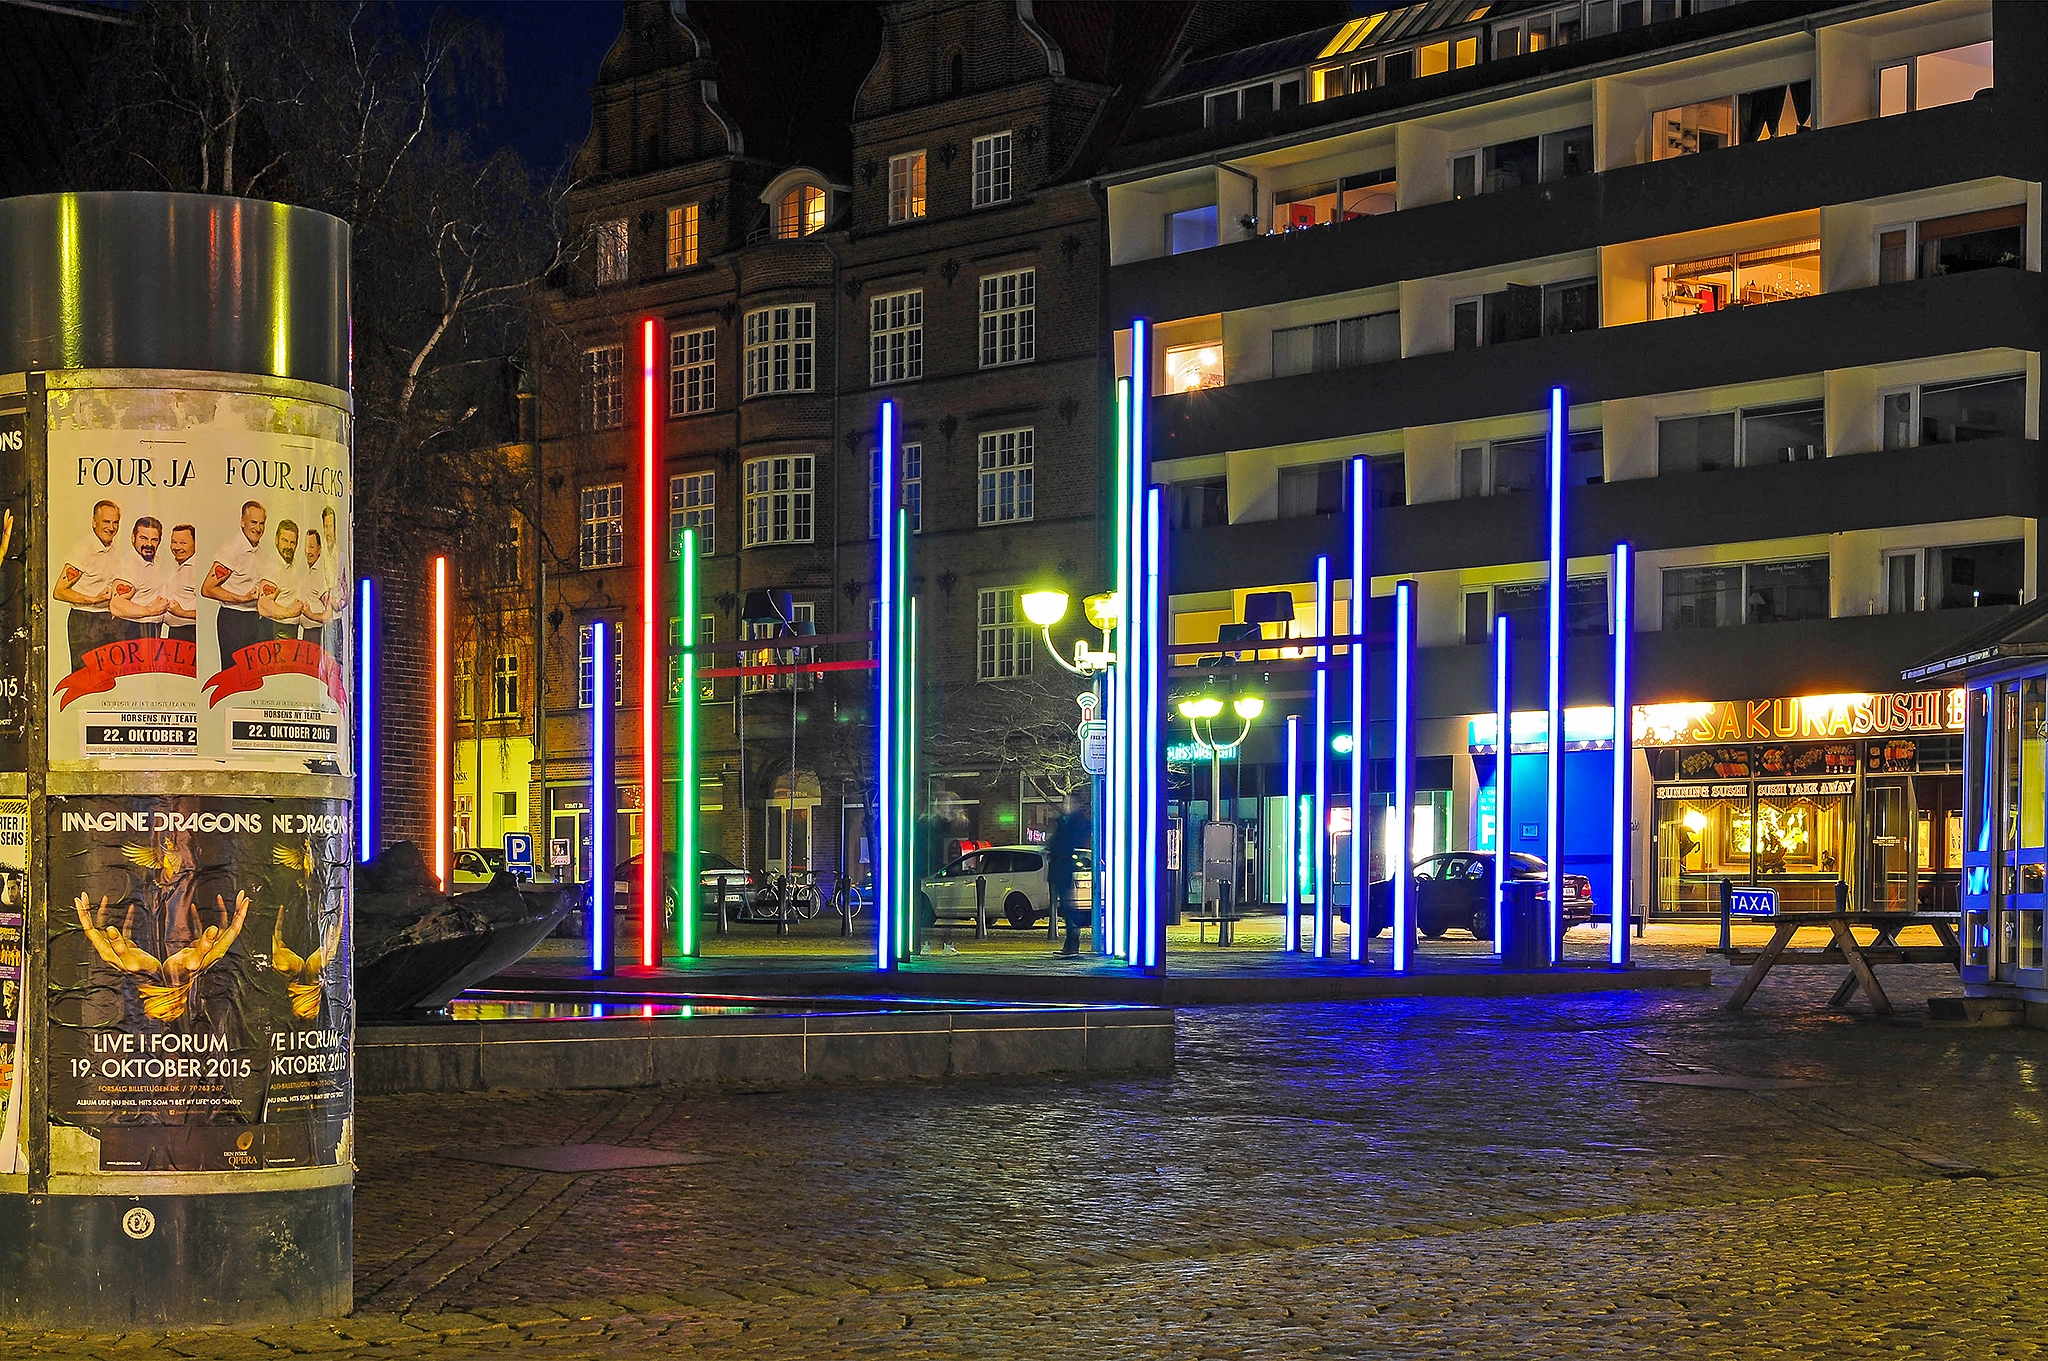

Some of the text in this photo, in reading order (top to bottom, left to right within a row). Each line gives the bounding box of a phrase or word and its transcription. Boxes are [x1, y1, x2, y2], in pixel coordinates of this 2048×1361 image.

[77, 457, 156, 487] FOUR
[225, 457, 344, 497] FOUR JACKS
[95, 642, 144, 672] FOR
[243, 642, 286, 670] FOR
[121, 714, 158, 722] HORSENS
[161, 714, 172, 722] NY
[264, 710, 321, 720] HORSENS NY TEATER
[1691, 698, 1856, 740] SAKURA
[1853, 691, 1943, 733] SUSHI
[103, 729, 196, 743] 22. OKTOBER 2
[248, 724, 330, 740] 22. OKTOBER 2015
[1656, 785, 1748, 799] RUNNING SUSHI
[1757, 780, 1855, 796] SUSHI TAKE AWAY
[61, 812, 263, 834] IMAGINE DRAGONS
[272, 815, 293, 834] NE
[0, 832, 24, 846] SENS
[512, 838, 527, 860] P
[1731, 895, 1771, 912] TAXA
[93, 1033, 229, 1053] LIVE I FORUM
[290, 1031, 295, 1051] I
[298, 1030, 340, 1050] FORUM
[70, 1058, 251, 1078] 19. OKTOBER 2015
[328, 1052, 347, 1072] 2015
[228, 1156, 258, 1165] OPERA
